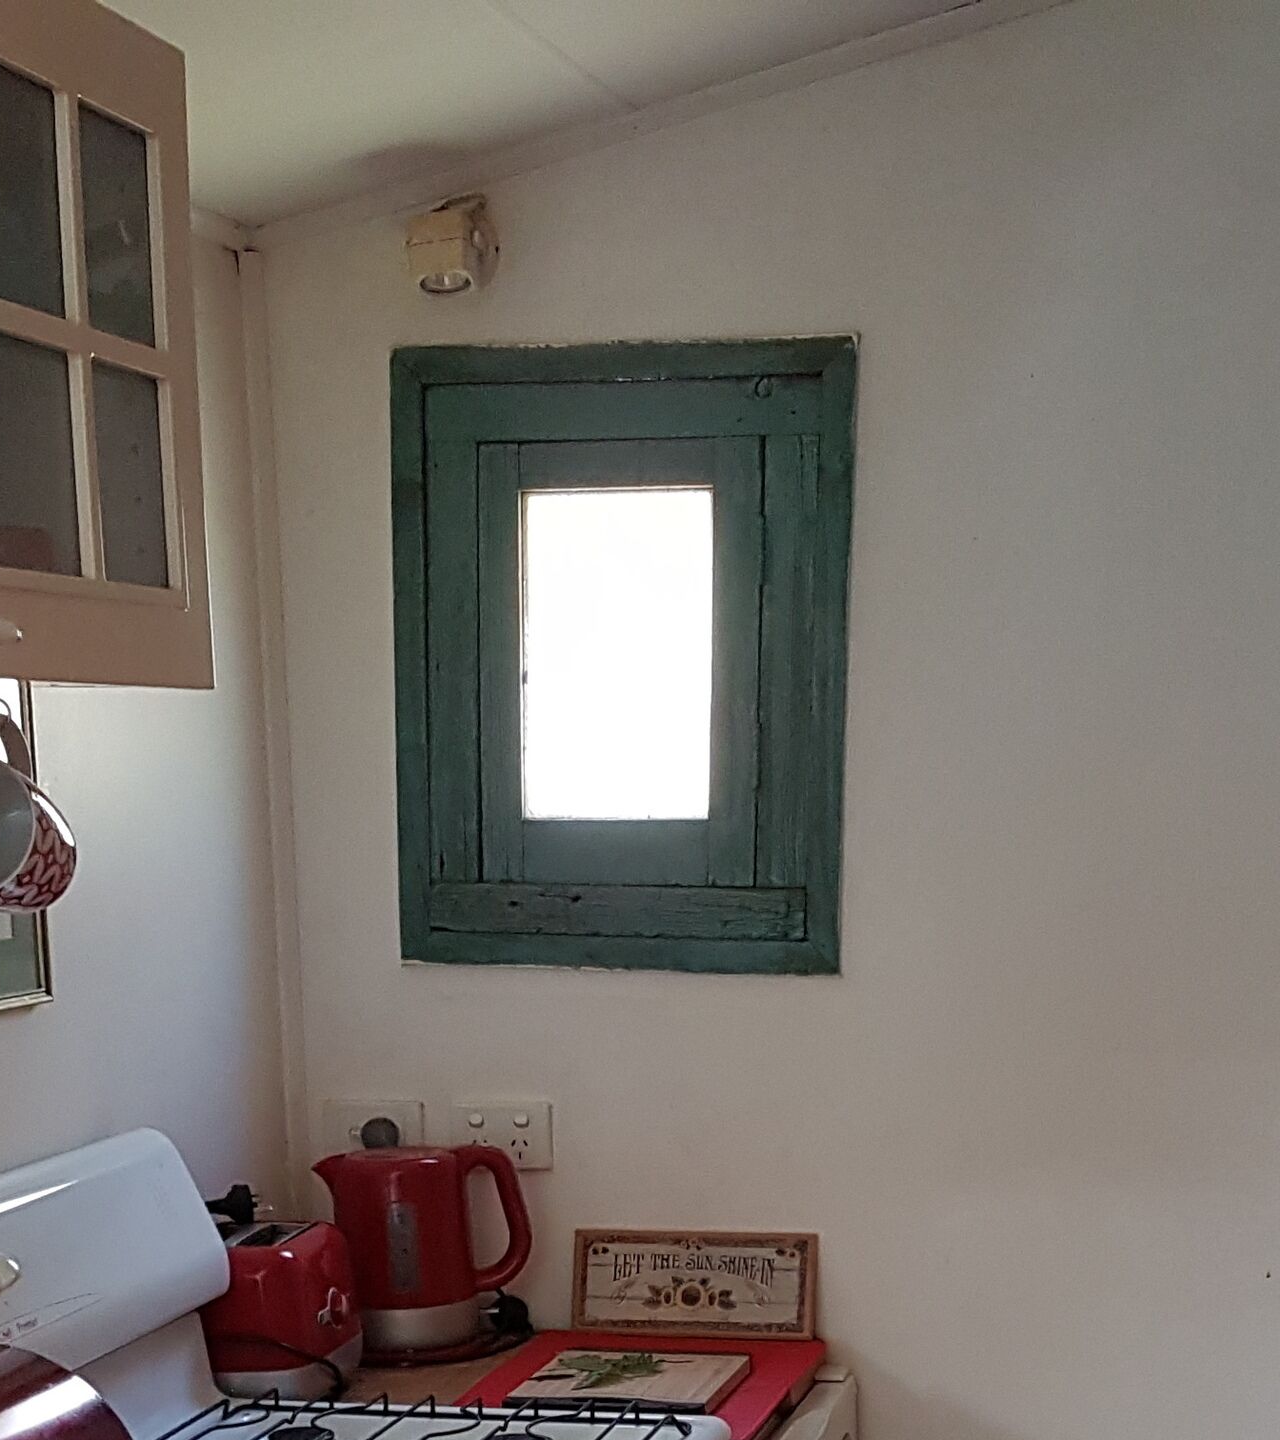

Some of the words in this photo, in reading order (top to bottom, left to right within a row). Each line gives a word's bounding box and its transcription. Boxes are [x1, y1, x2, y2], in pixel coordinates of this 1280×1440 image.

[613, 1253, 645, 1282] LET
[650, 1253, 680, 1272] THE
[684, 1253, 714, 1272] SUN
[760, 1258, 776, 1287] IN
